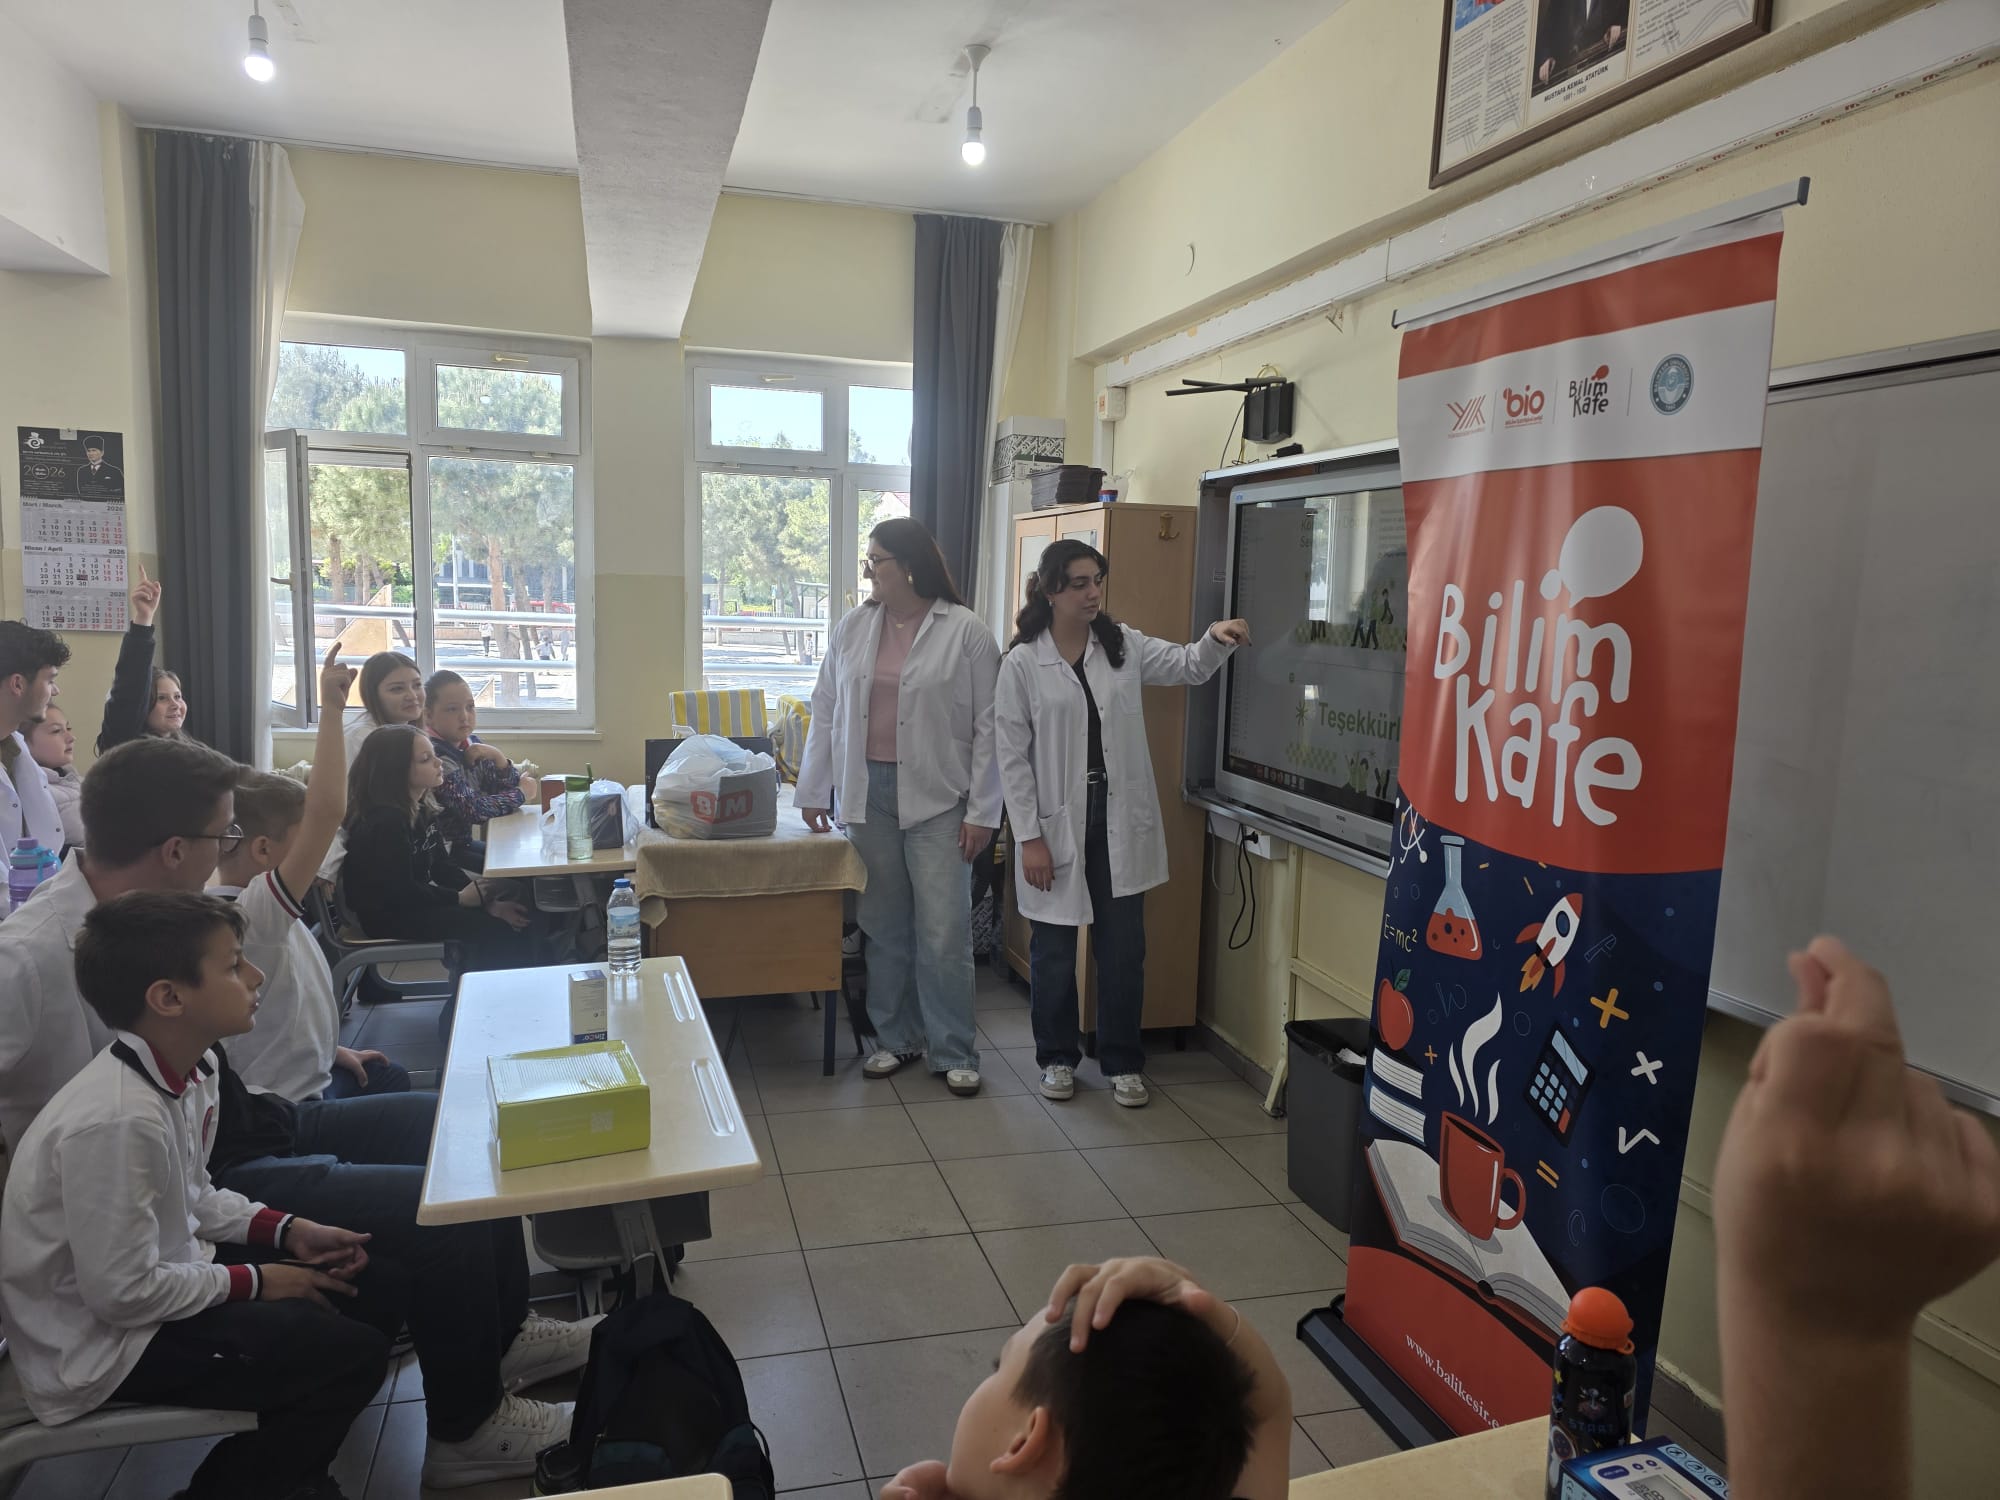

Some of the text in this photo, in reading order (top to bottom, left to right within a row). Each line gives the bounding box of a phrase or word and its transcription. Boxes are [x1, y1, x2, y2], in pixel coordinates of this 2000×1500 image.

[1544, 64, 1609, 102] MUSTAFA KEMAL ATATÜRK
[1502, 385, 1545, 418] bio
[1569, 377, 1608, 399] Bilim
[1572, 391, 1609, 418] Kafe
[1434, 569, 1632, 704] Bilim
[1455, 674, 1643, 828] Kafe
[1406, 1335, 1501, 1429] www.balikesir.e
